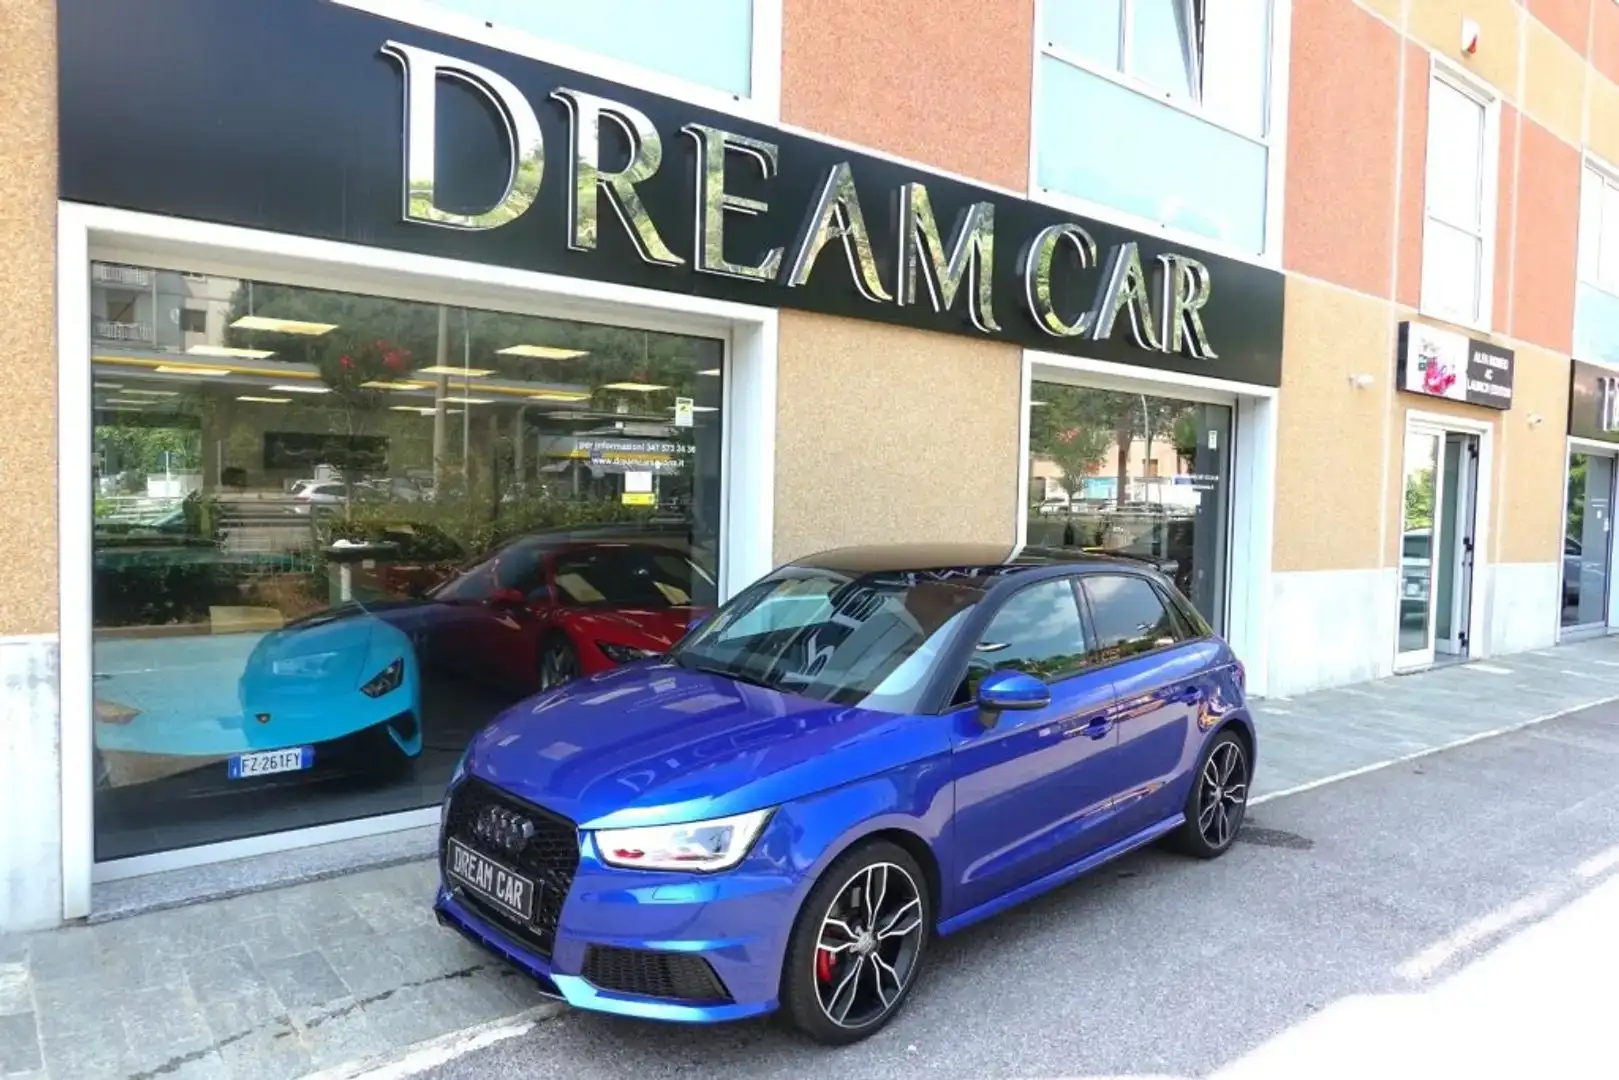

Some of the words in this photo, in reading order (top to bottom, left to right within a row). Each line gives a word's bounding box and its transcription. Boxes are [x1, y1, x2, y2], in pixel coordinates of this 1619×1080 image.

[380, 39, 1002, 333] DREAM
[1025, 222, 1219, 360] CAR
[453, 846, 493, 892] DREAM
[496, 871, 523, 910] CAR
